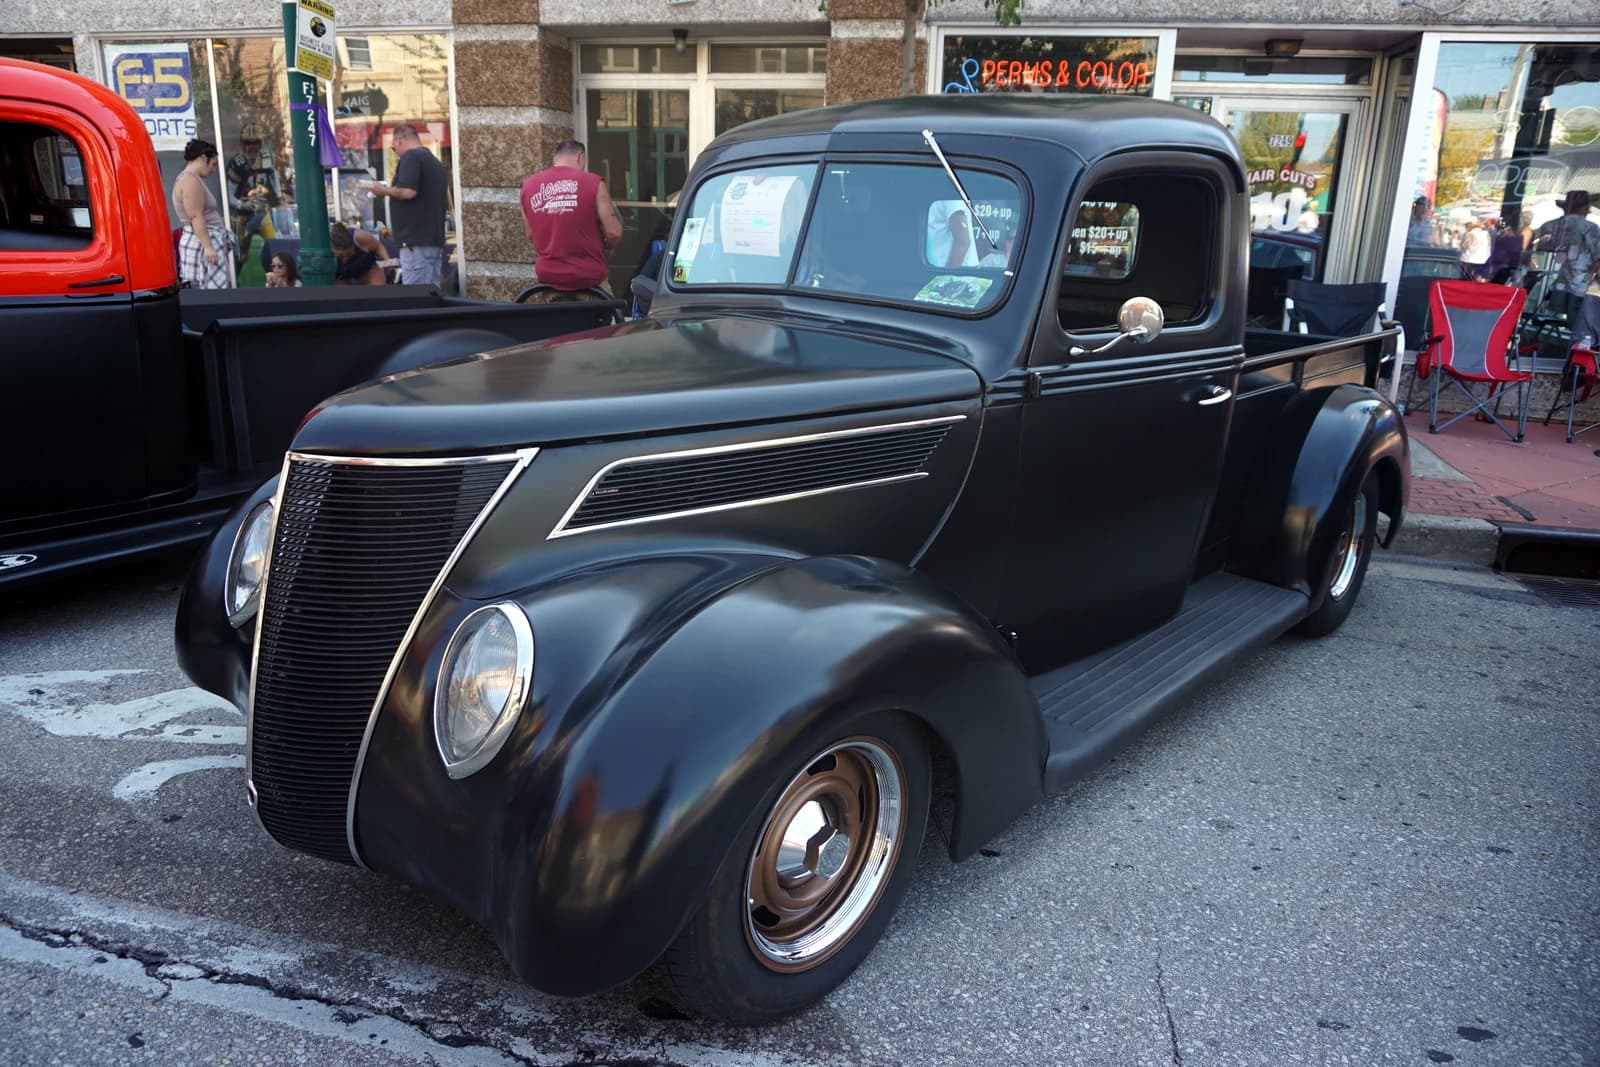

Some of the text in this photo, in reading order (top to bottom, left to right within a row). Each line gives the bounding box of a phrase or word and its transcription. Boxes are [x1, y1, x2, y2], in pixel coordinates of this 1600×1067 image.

[982, 59, 1149, 88] PERMS & COLOR
[1269, 135, 1295, 148] 7249
[1280, 168, 1316, 189] CUTS
